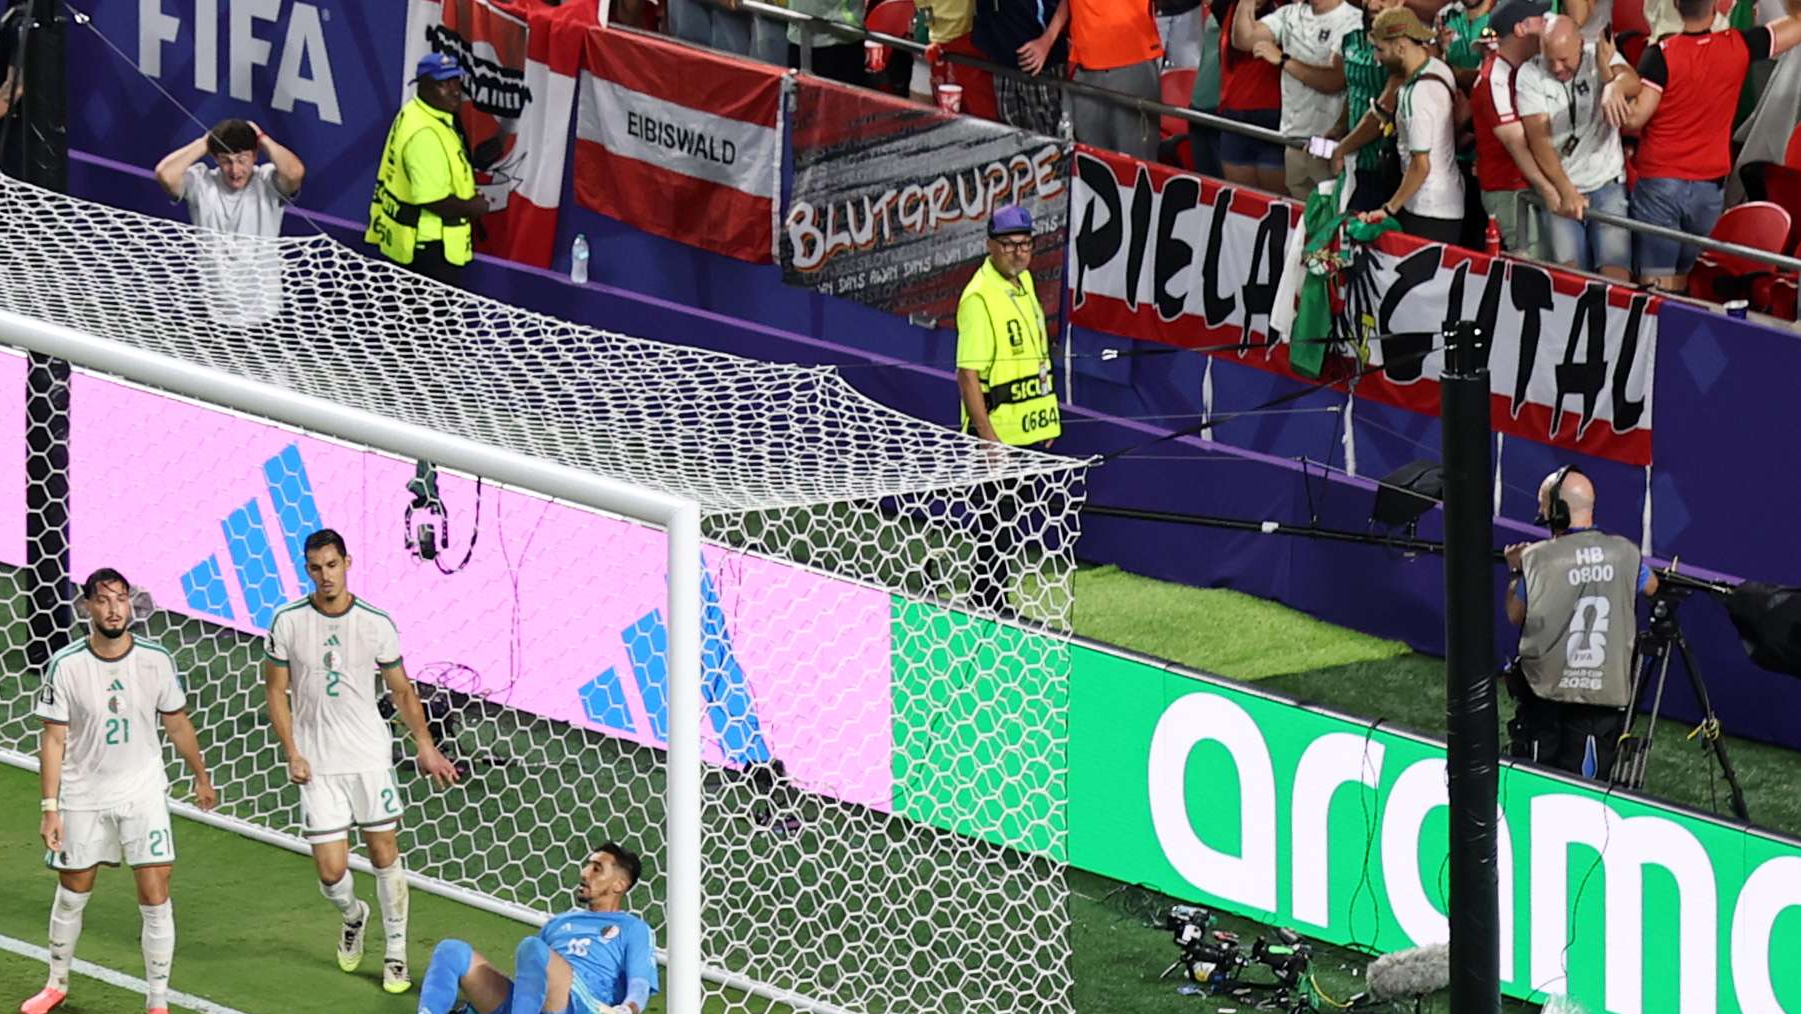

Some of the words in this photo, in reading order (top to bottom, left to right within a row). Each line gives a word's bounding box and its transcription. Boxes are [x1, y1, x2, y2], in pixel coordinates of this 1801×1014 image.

[139, 0, 342, 125] FIFA
[627, 111, 736, 165] EIBISWALD
[786, 144, 1066, 271] BLUTGRUPPE
[1575, 547, 1604, 566] HB
[1568, 564, 1614, 586] 0800
[326, 670, 341, 697] 2
[1558, 677, 1603, 690] 2026
[105, 718, 130, 745] 21
[380, 788, 399, 814] 2
[149, 828, 171, 856] 21
